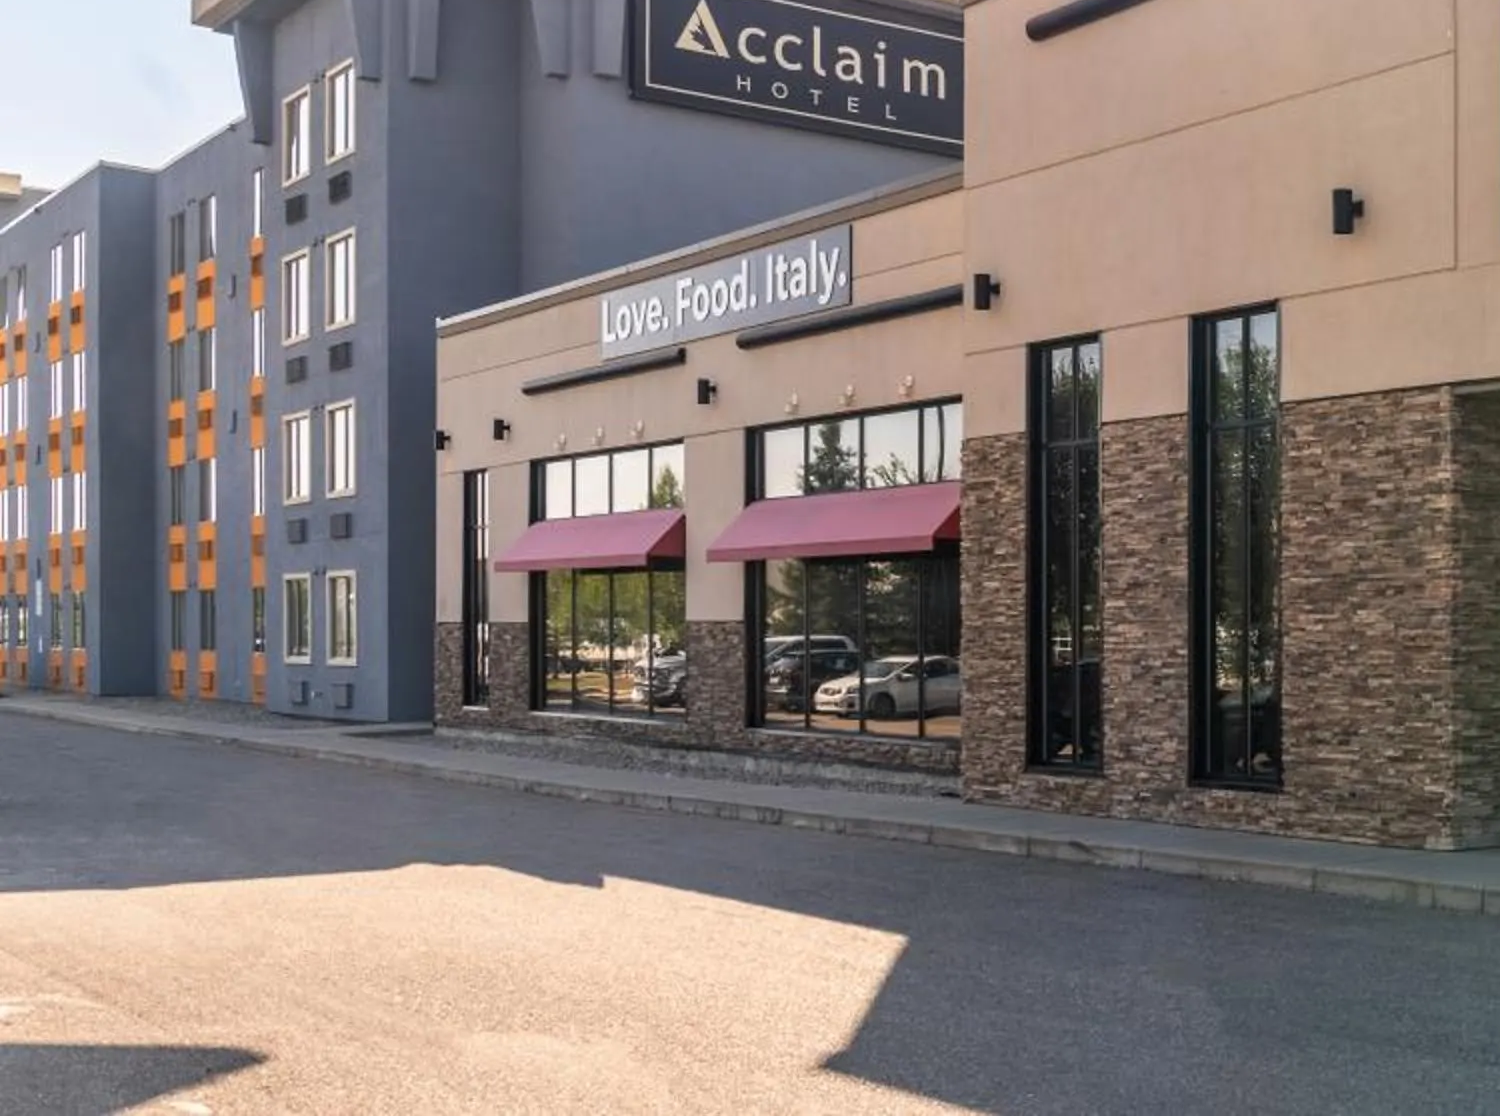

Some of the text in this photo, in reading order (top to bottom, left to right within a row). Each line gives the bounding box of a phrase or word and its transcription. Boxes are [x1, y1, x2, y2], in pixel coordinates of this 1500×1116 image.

[736, 74, 897, 121] HOTEL
[602, 239, 847, 344] Love. Food. Italy.
